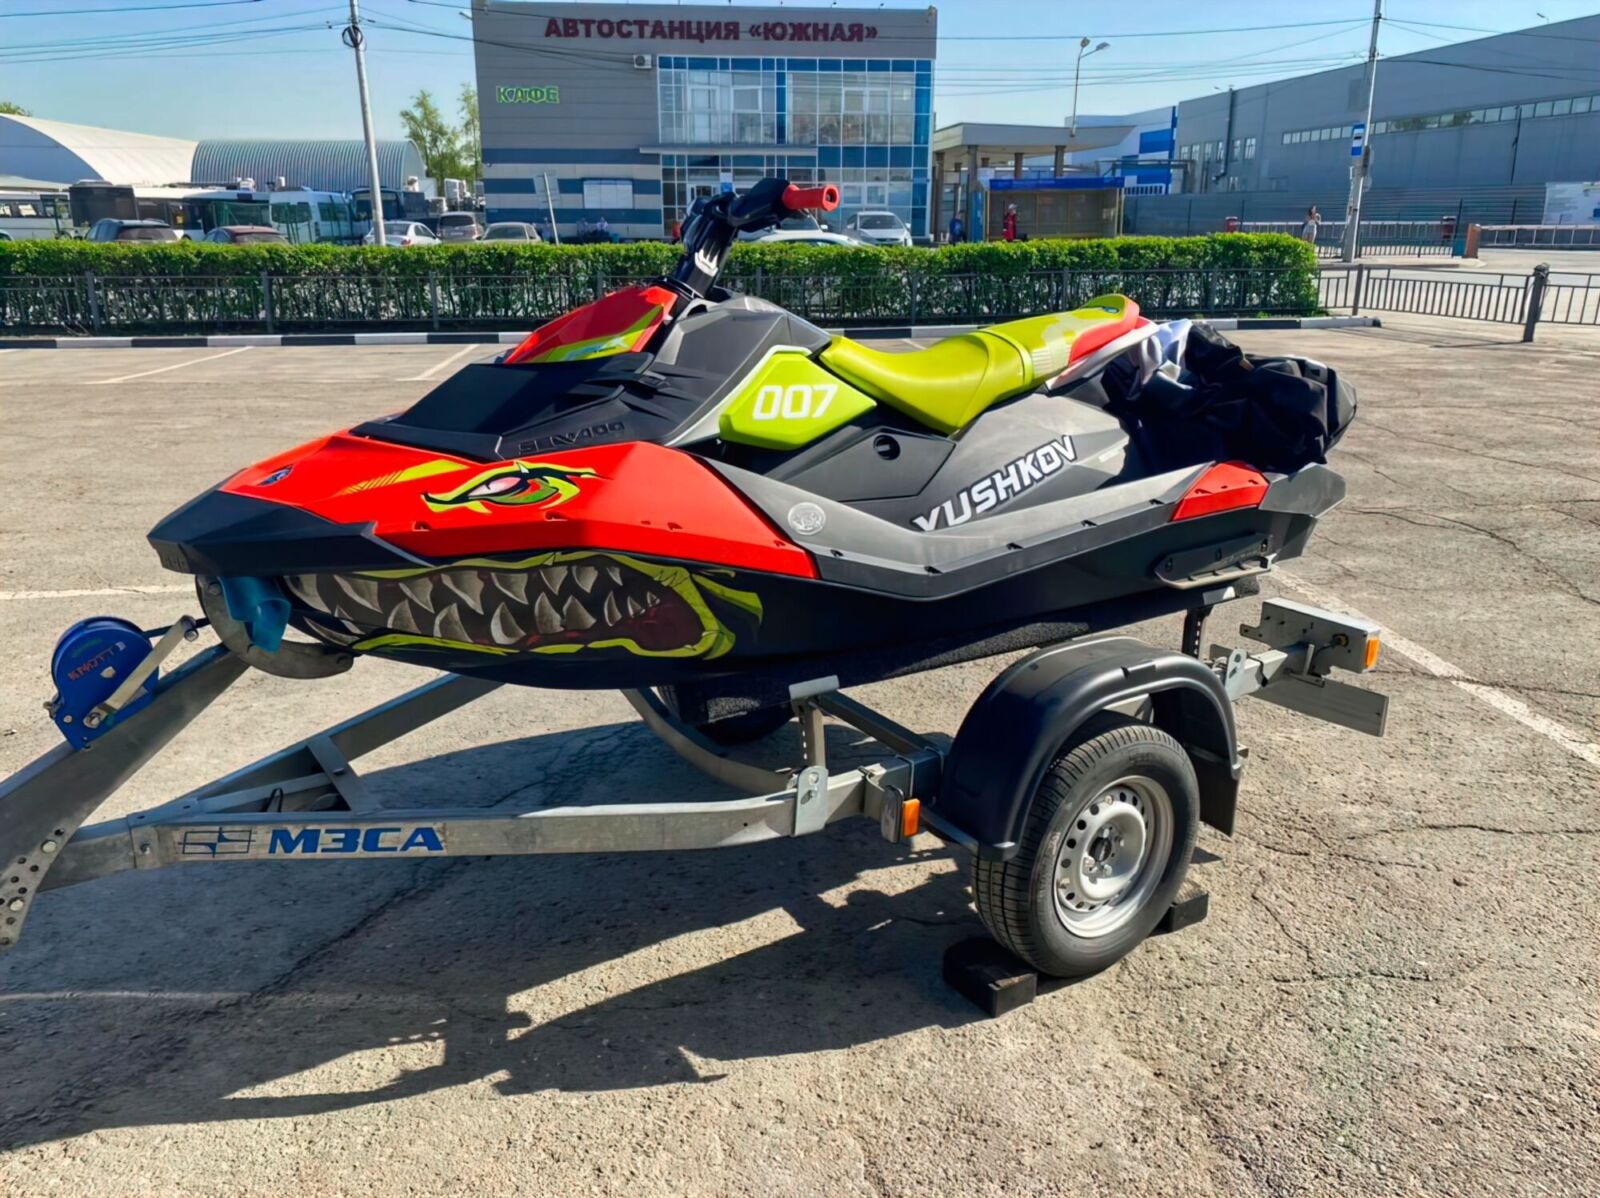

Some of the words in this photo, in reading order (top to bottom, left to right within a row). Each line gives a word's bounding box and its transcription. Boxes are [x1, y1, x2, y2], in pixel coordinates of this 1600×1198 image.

[544, 18, 740, 43] АВТОСТАНЦИЯ
[750, 21, 878, 42] «ЮЖНАЯ»
[496, 86, 560, 104] КАФЕ
[752, 384, 838, 420] 007
[911, 434, 1078, 532] YUSHKOV
[268, 827, 444, 854] МЗСА
